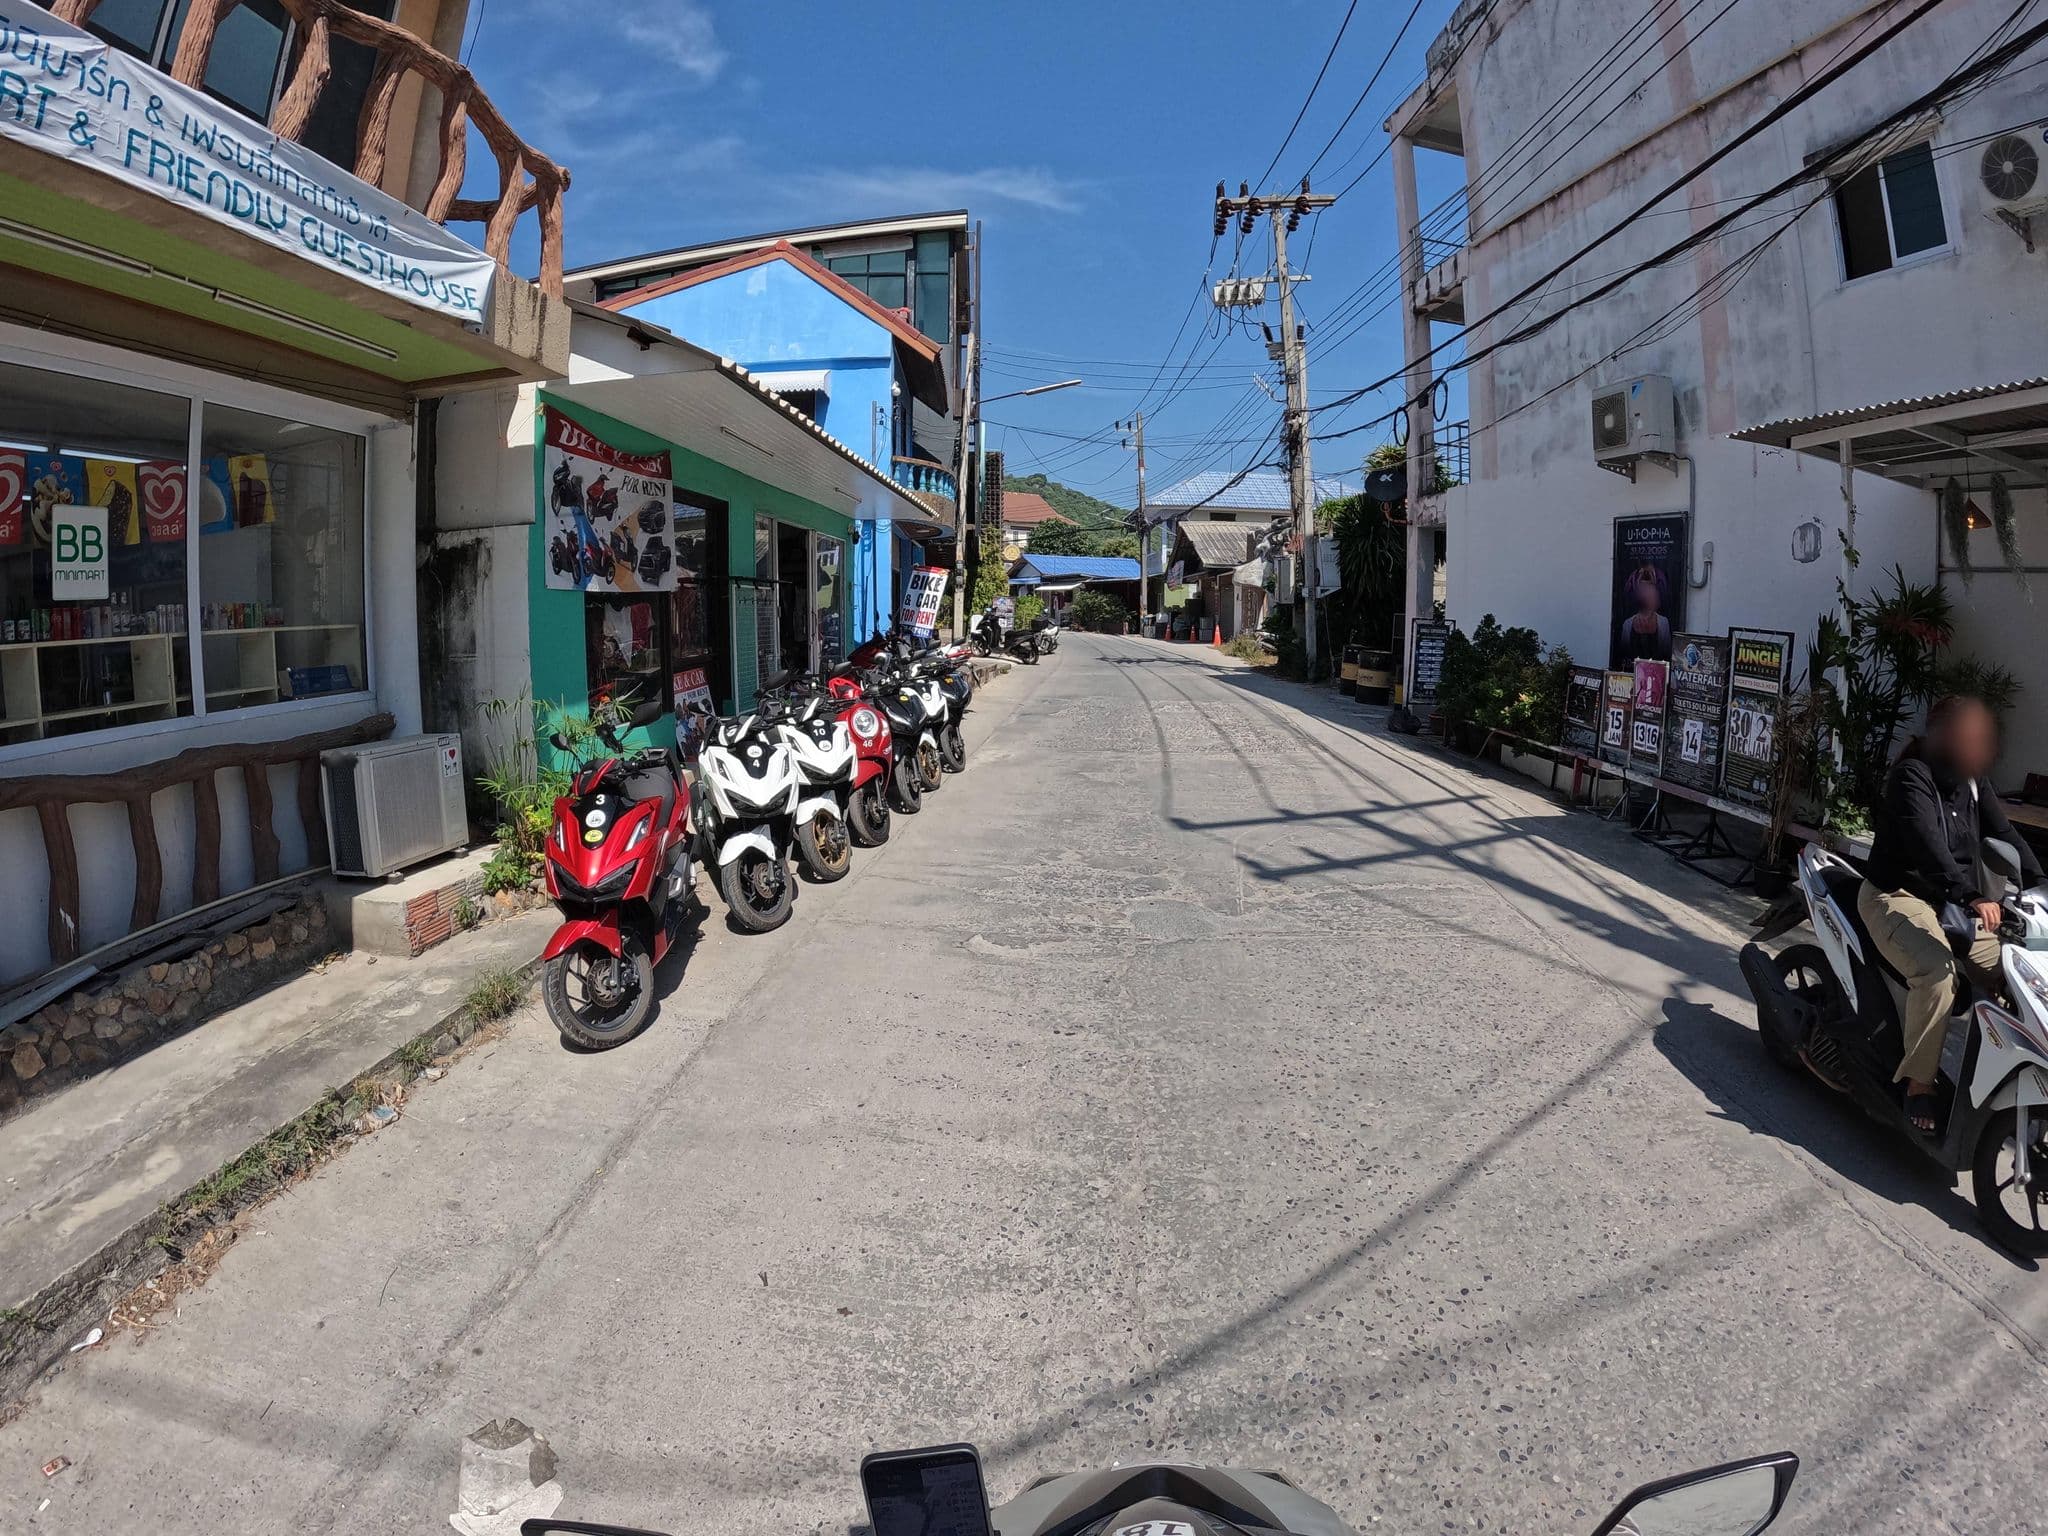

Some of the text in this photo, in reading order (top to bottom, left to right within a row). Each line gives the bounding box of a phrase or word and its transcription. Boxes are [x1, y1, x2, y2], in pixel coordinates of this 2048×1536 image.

[145, 94, 165, 131] &
[68, 110, 96, 150] &
[123, 127, 288, 233] FRIENDLY
[300, 216, 482, 311] GUESTHOUSE
[621, 474, 666, 497] FOR RENT
[56, 524, 104, 562] BB
[55, 569, 105, 581] MINIMART
[910, 574, 943, 592] BIKE
[904, 593, 938, 610] & CAR
[916, 611, 935, 625] RENT
[1736, 647, 1780, 667] JUNGLE
[691, 670, 706, 686] CAR
[1672, 669, 1722, 687] WATERFALL
[1673, 697, 1691, 709] TICKETS
[1691, 702, 1707, 712] SOLD
[1610, 711, 1622, 730] 15
[1731, 709, 1767, 742] 30 2
[813, 728, 826, 736] 10
[1608, 731, 1620, 743] JAN
[1635, 724, 1658, 745] 13 16
[1686, 730, 1698, 755] 14
[1730, 735, 1769, 760] DEC JAN
[752, 759, 760, 768] 4
[595, 794, 606, 805] 3
